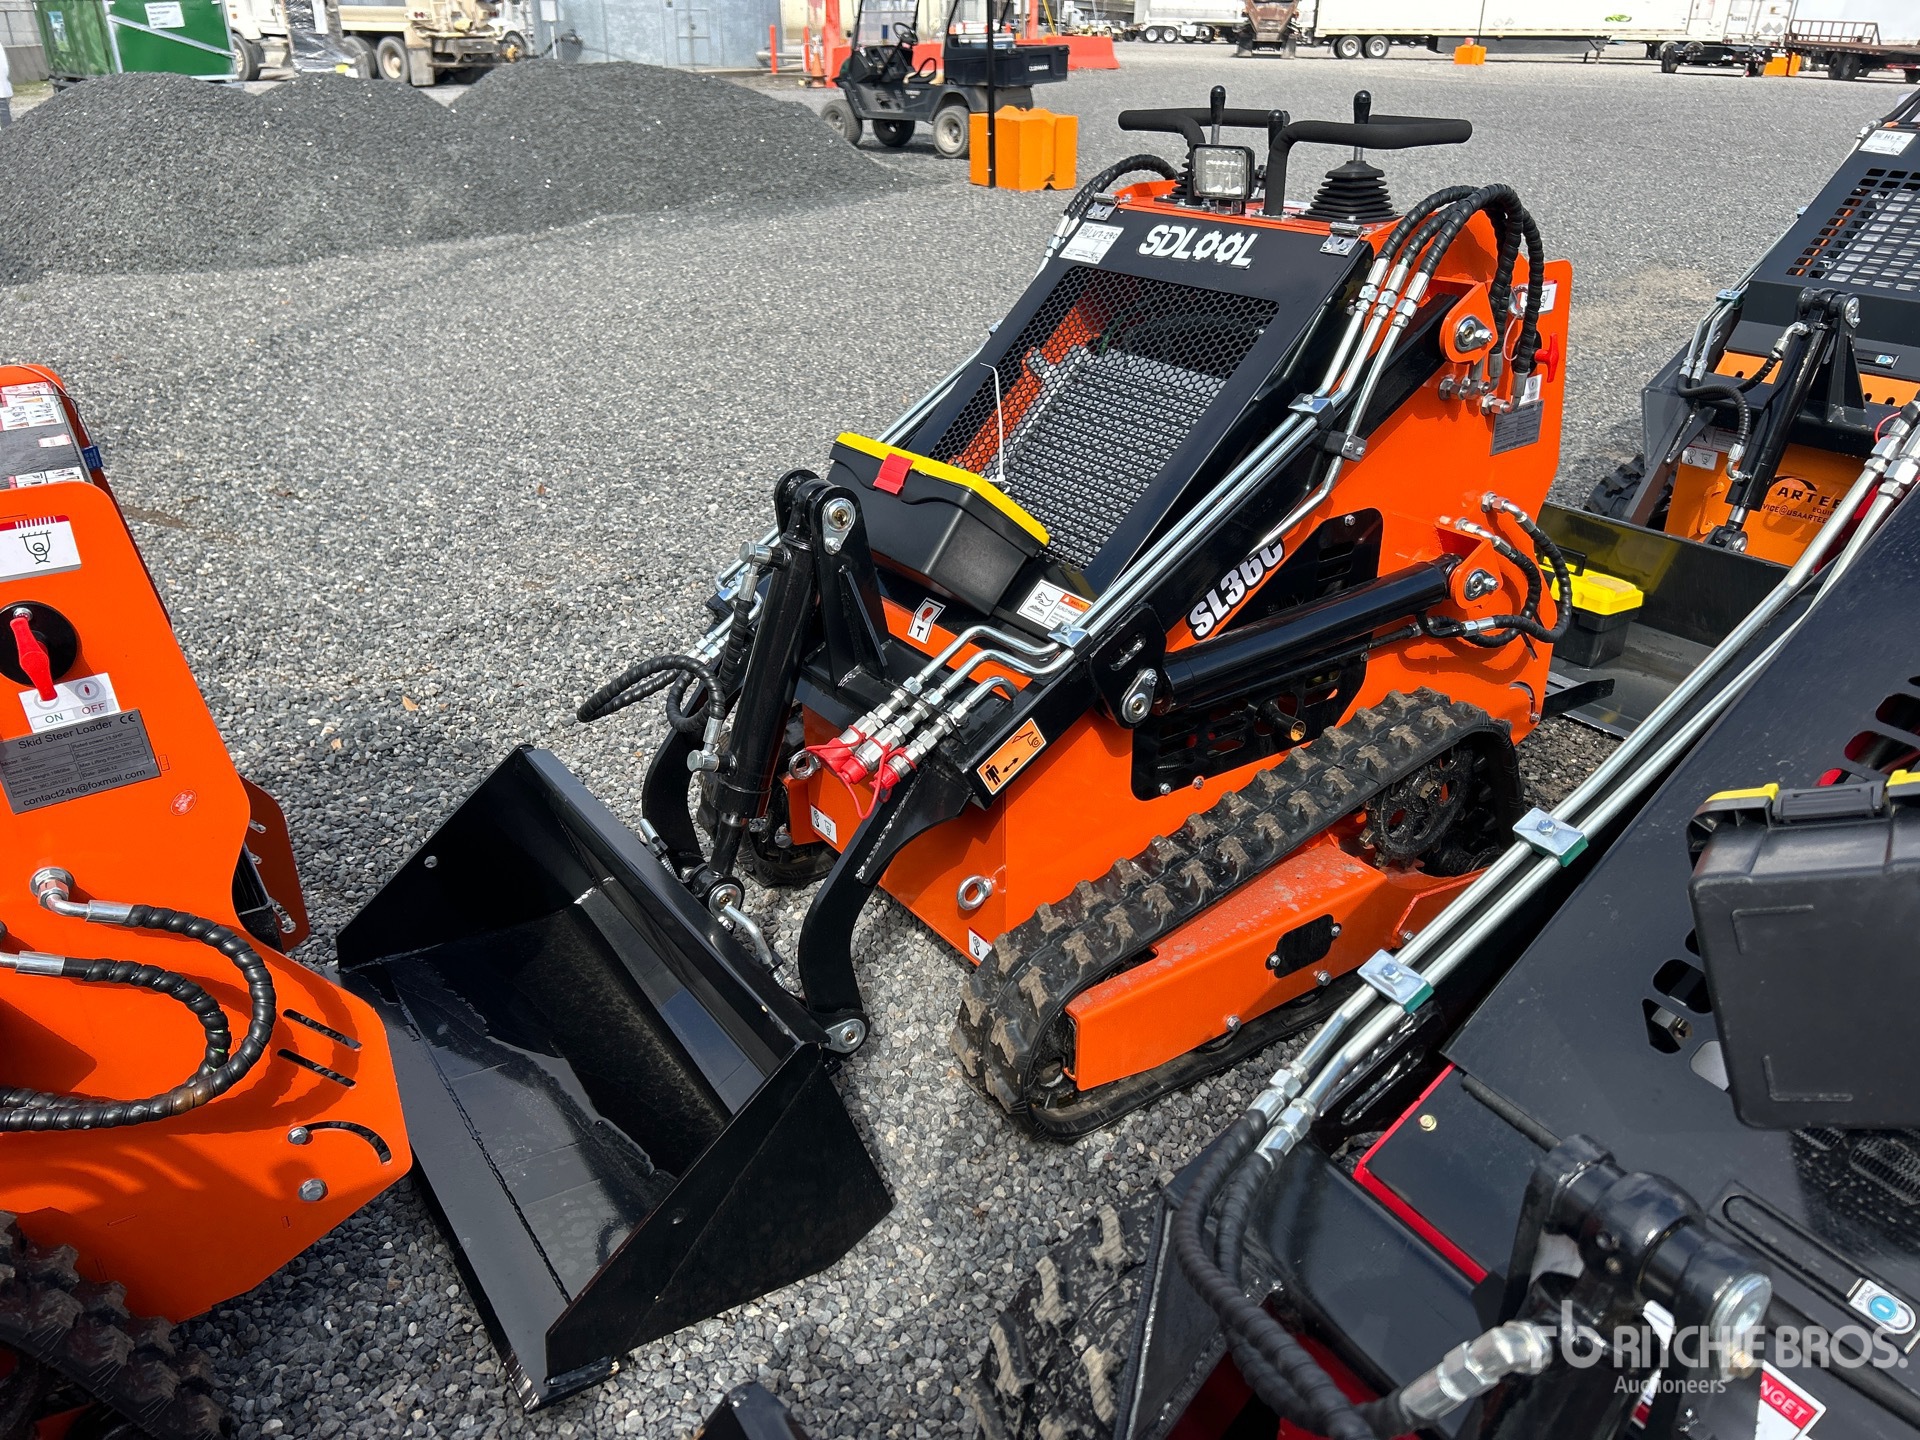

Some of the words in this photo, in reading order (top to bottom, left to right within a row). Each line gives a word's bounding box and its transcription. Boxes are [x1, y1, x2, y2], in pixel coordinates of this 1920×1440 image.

[1138, 224, 1258, 269] SDLOOL
[1189, 541, 1283, 637] SL36C
[45, 713, 64, 723] ON
[82, 703, 105, 714] OFF
[18, 737, 42, 749] Skid
[44, 729, 74, 743] Steer
[75, 720, 113, 735] Loader
[23, 769, 146, 807] contact24h@foxmail.com
